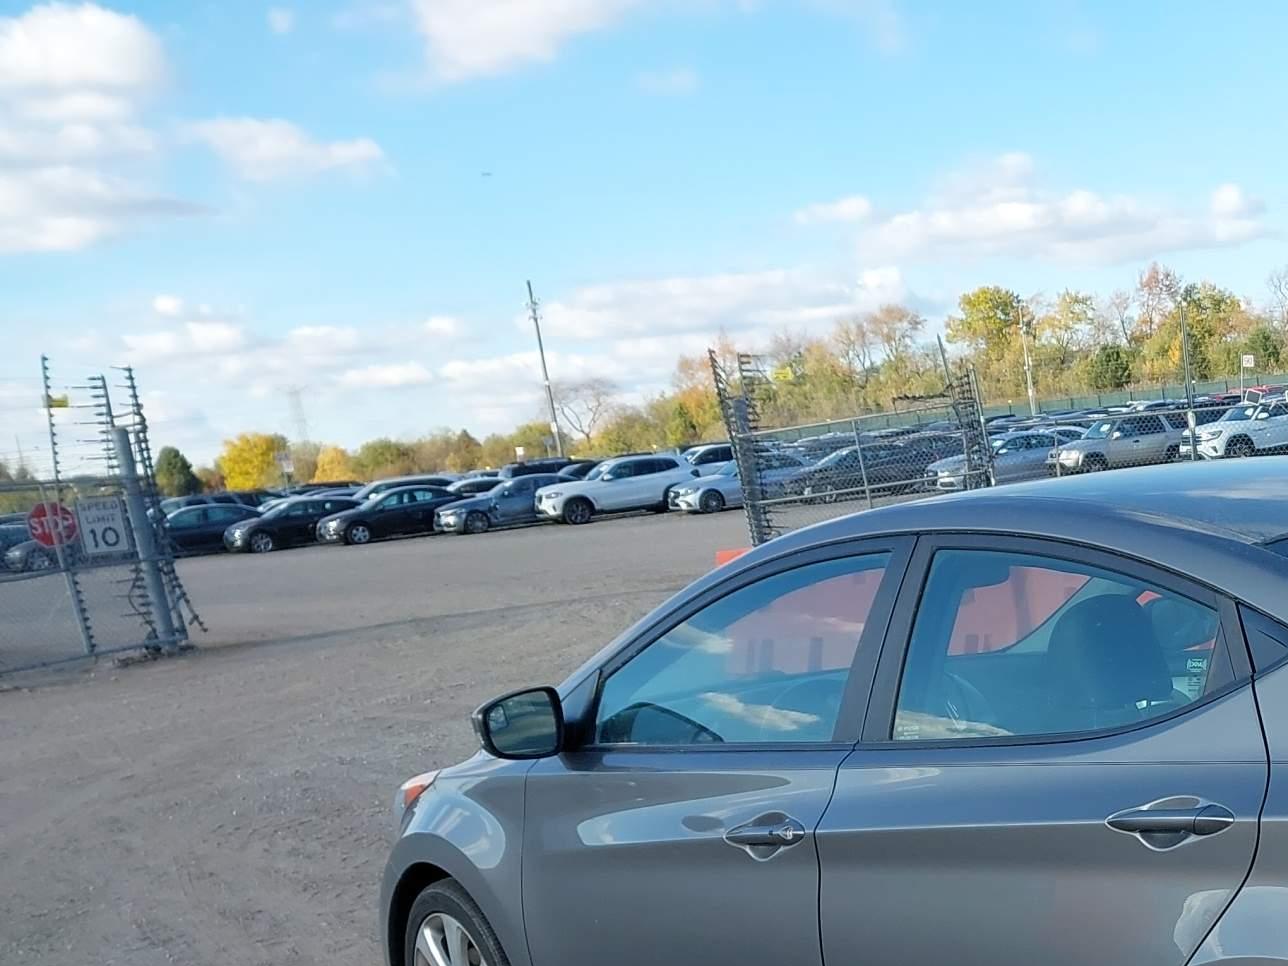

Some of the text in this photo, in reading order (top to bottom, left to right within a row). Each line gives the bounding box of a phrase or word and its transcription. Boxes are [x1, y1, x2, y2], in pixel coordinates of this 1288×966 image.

[79, 502, 118, 511] SPEED
[85, 513, 116, 524] LIMIT
[90, 526, 120, 549] 10
